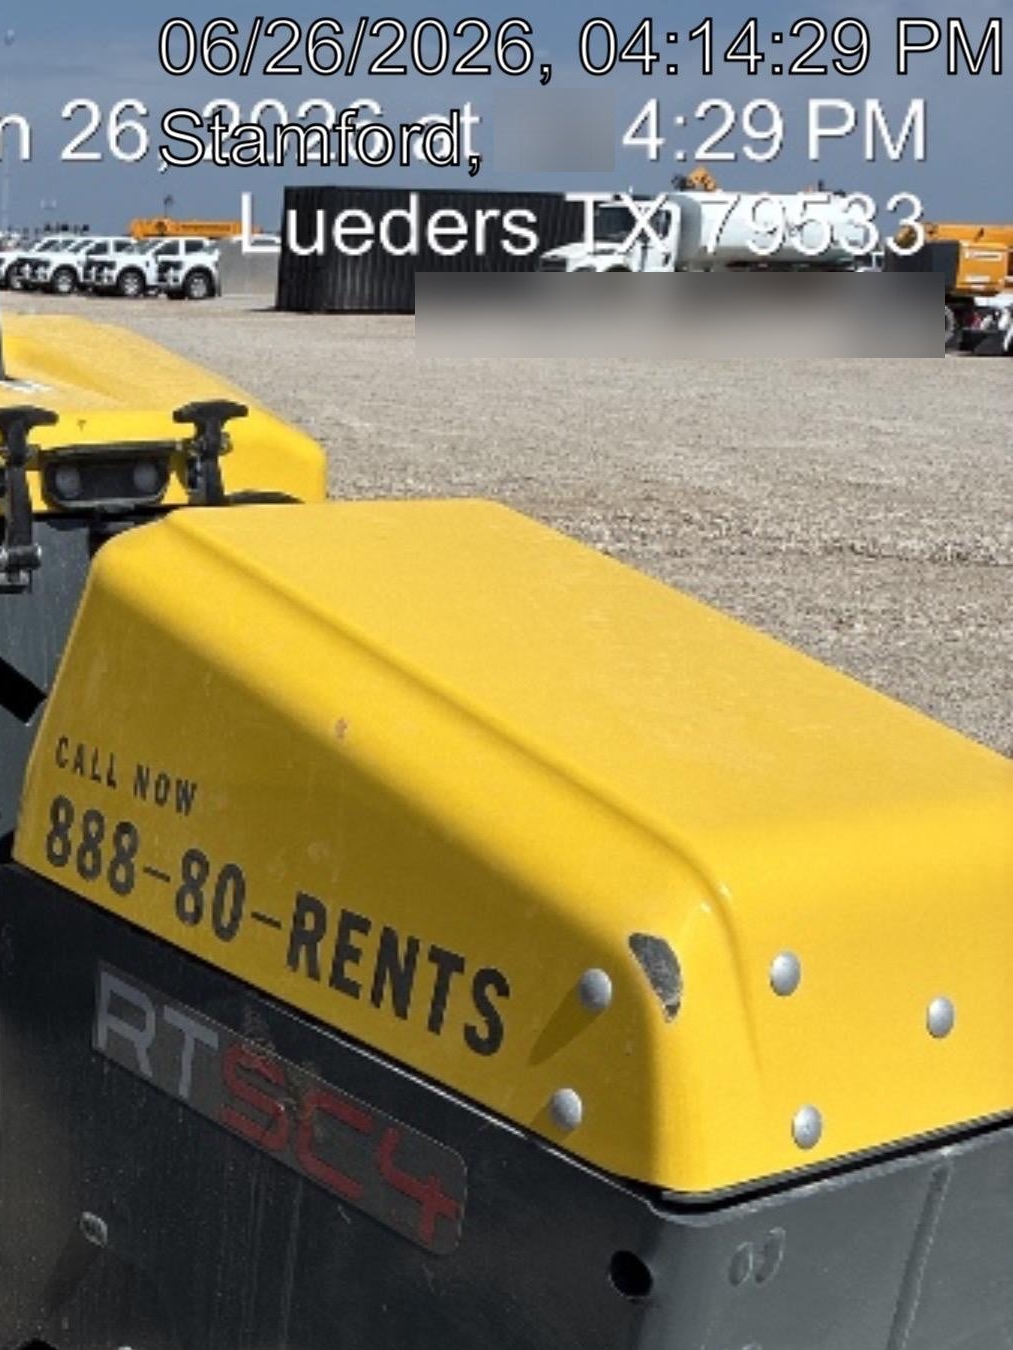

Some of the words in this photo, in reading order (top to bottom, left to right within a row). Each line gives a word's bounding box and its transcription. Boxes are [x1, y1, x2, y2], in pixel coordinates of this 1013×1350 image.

[54, 735, 118, 790] CALL
[133, 762, 198, 817] NOW
[45, 795, 511, 1057] 888-80-RENTS
